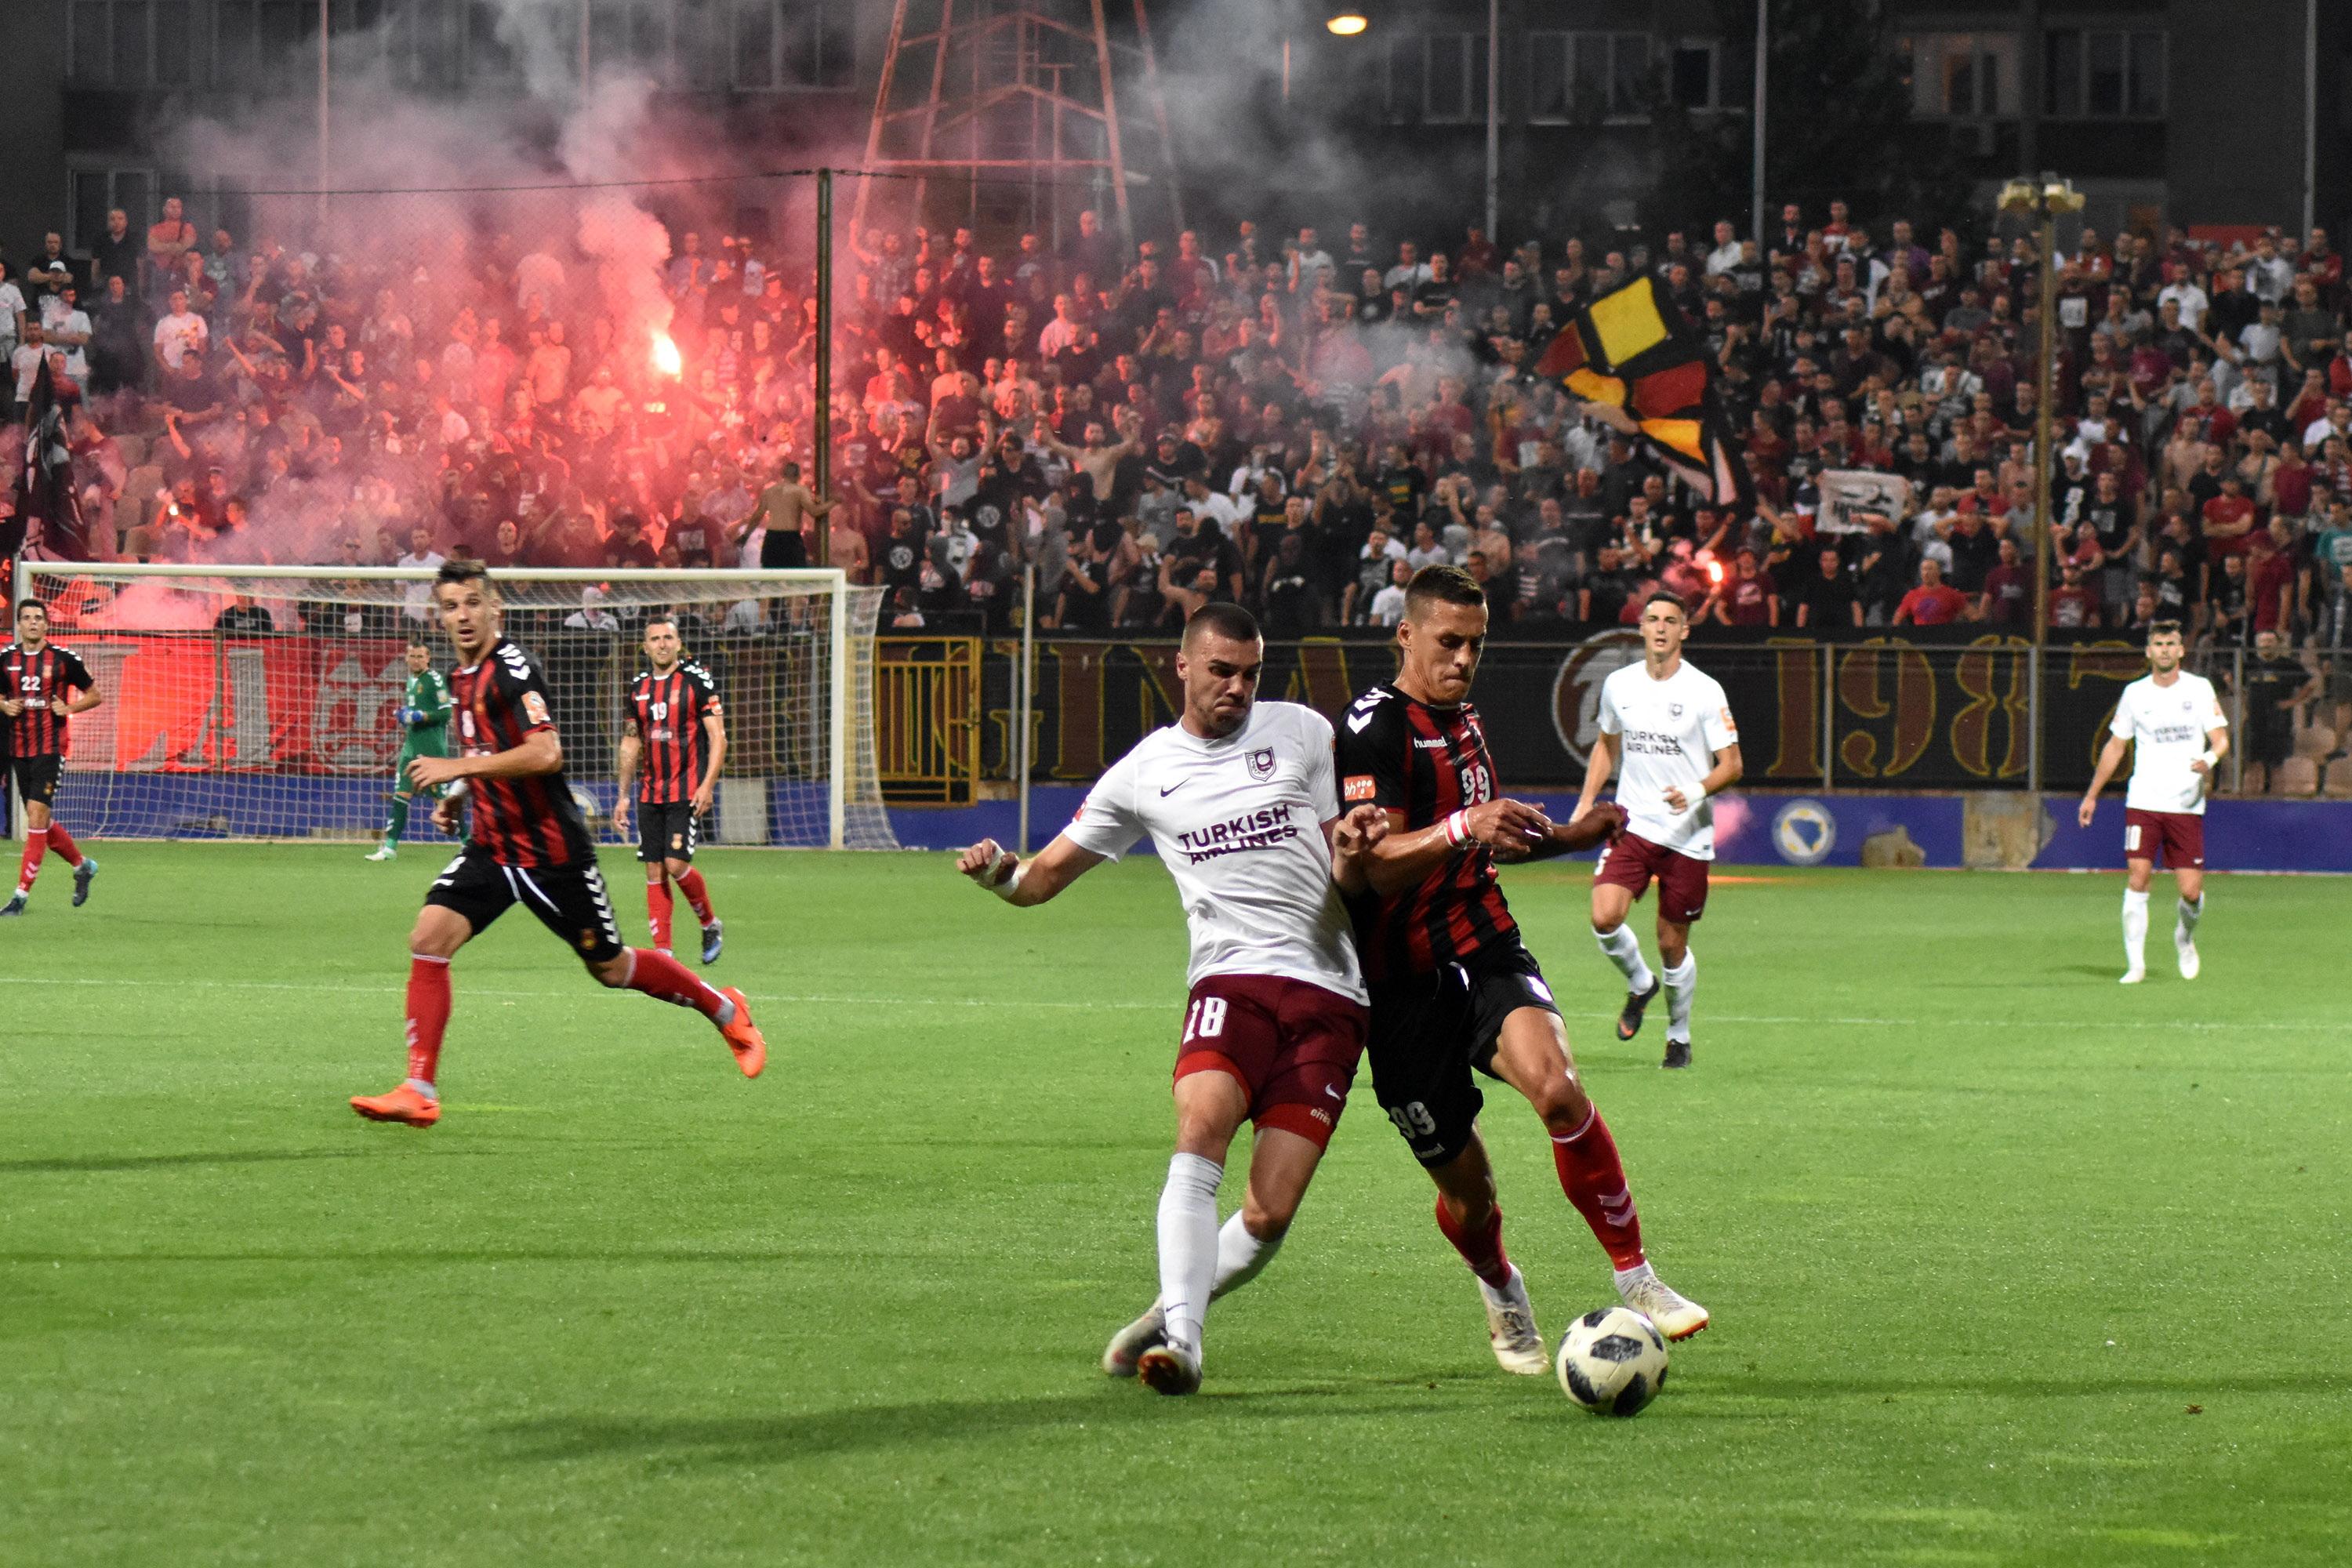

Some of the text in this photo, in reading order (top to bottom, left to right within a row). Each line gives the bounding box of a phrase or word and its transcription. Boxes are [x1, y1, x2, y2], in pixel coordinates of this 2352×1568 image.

[20, 676, 41, 691] 22
[650, 701, 667, 720] 19
[1414, 736, 1447, 749] hummel
[1624, 729, 1679, 744] TURKISH
[1626, 742, 1682, 756] AIRLINES
[1461, 765, 1490, 806] 99
[1178, 804, 1290, 851] TURKISH
[2125, 825, 2141, 851] 10
[1190, 824, 1298, 866] AIRLINES
[1183, 996, 1228, 1044] 18
[1390, 1101, 1436, 1139] 99
